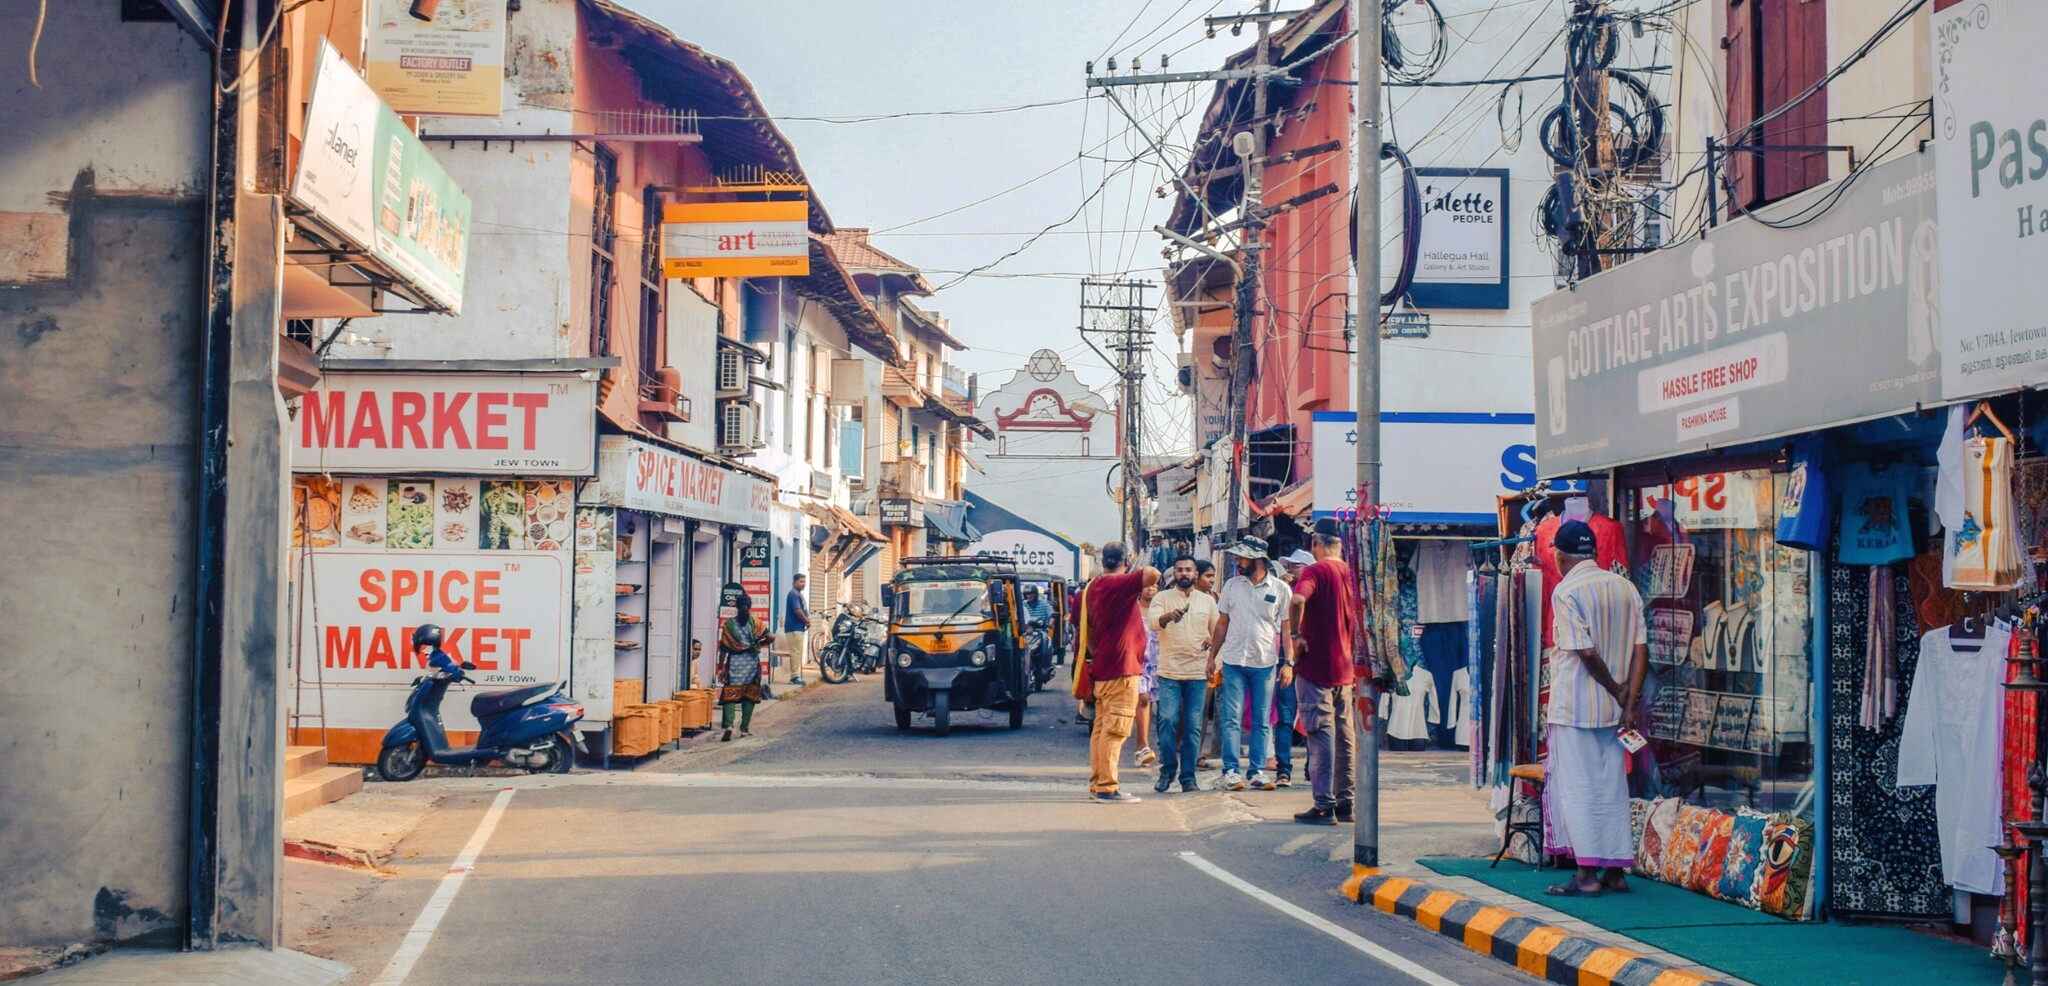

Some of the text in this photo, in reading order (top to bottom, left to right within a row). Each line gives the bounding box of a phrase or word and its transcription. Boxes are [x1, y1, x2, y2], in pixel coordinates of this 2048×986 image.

[402, 57, 468, 70] FACTORY OUTLET
[1453, 215, 1493, 224] PEOPLE
[718, 230, 795, 251] art STUDIO
[758, 240, 800, 248] GALLERY
[1424, 251, 1489, 262] Hallegua Hall
[1424, 264, 1447, 272] Gallery
[1567, 215, 1903, 380] COTTAGE ARTS EXPOSITION
[1960, 338, 1974, 353] No:
[2010, 326, 2048, 346] Jewtown
[1662, 357, 1758, 400] HASSLE FREE SHOP
[301, 384, 569, 450] MARKET TM
[1204, 415, 1225, 425] YOUR
[1681, 406, 1727, 430] PASHMINA HOUSE
[494, 459, 559, 467] JEW TOWN
[636, 450, 725, 506] SPICE MARKET
[746, 548, 766, 559] OILS
[504, 563, 521, 572] TM
[358, 568, 501, 613] SPICE
[485, 674, 536, 683] JEW TOWN
